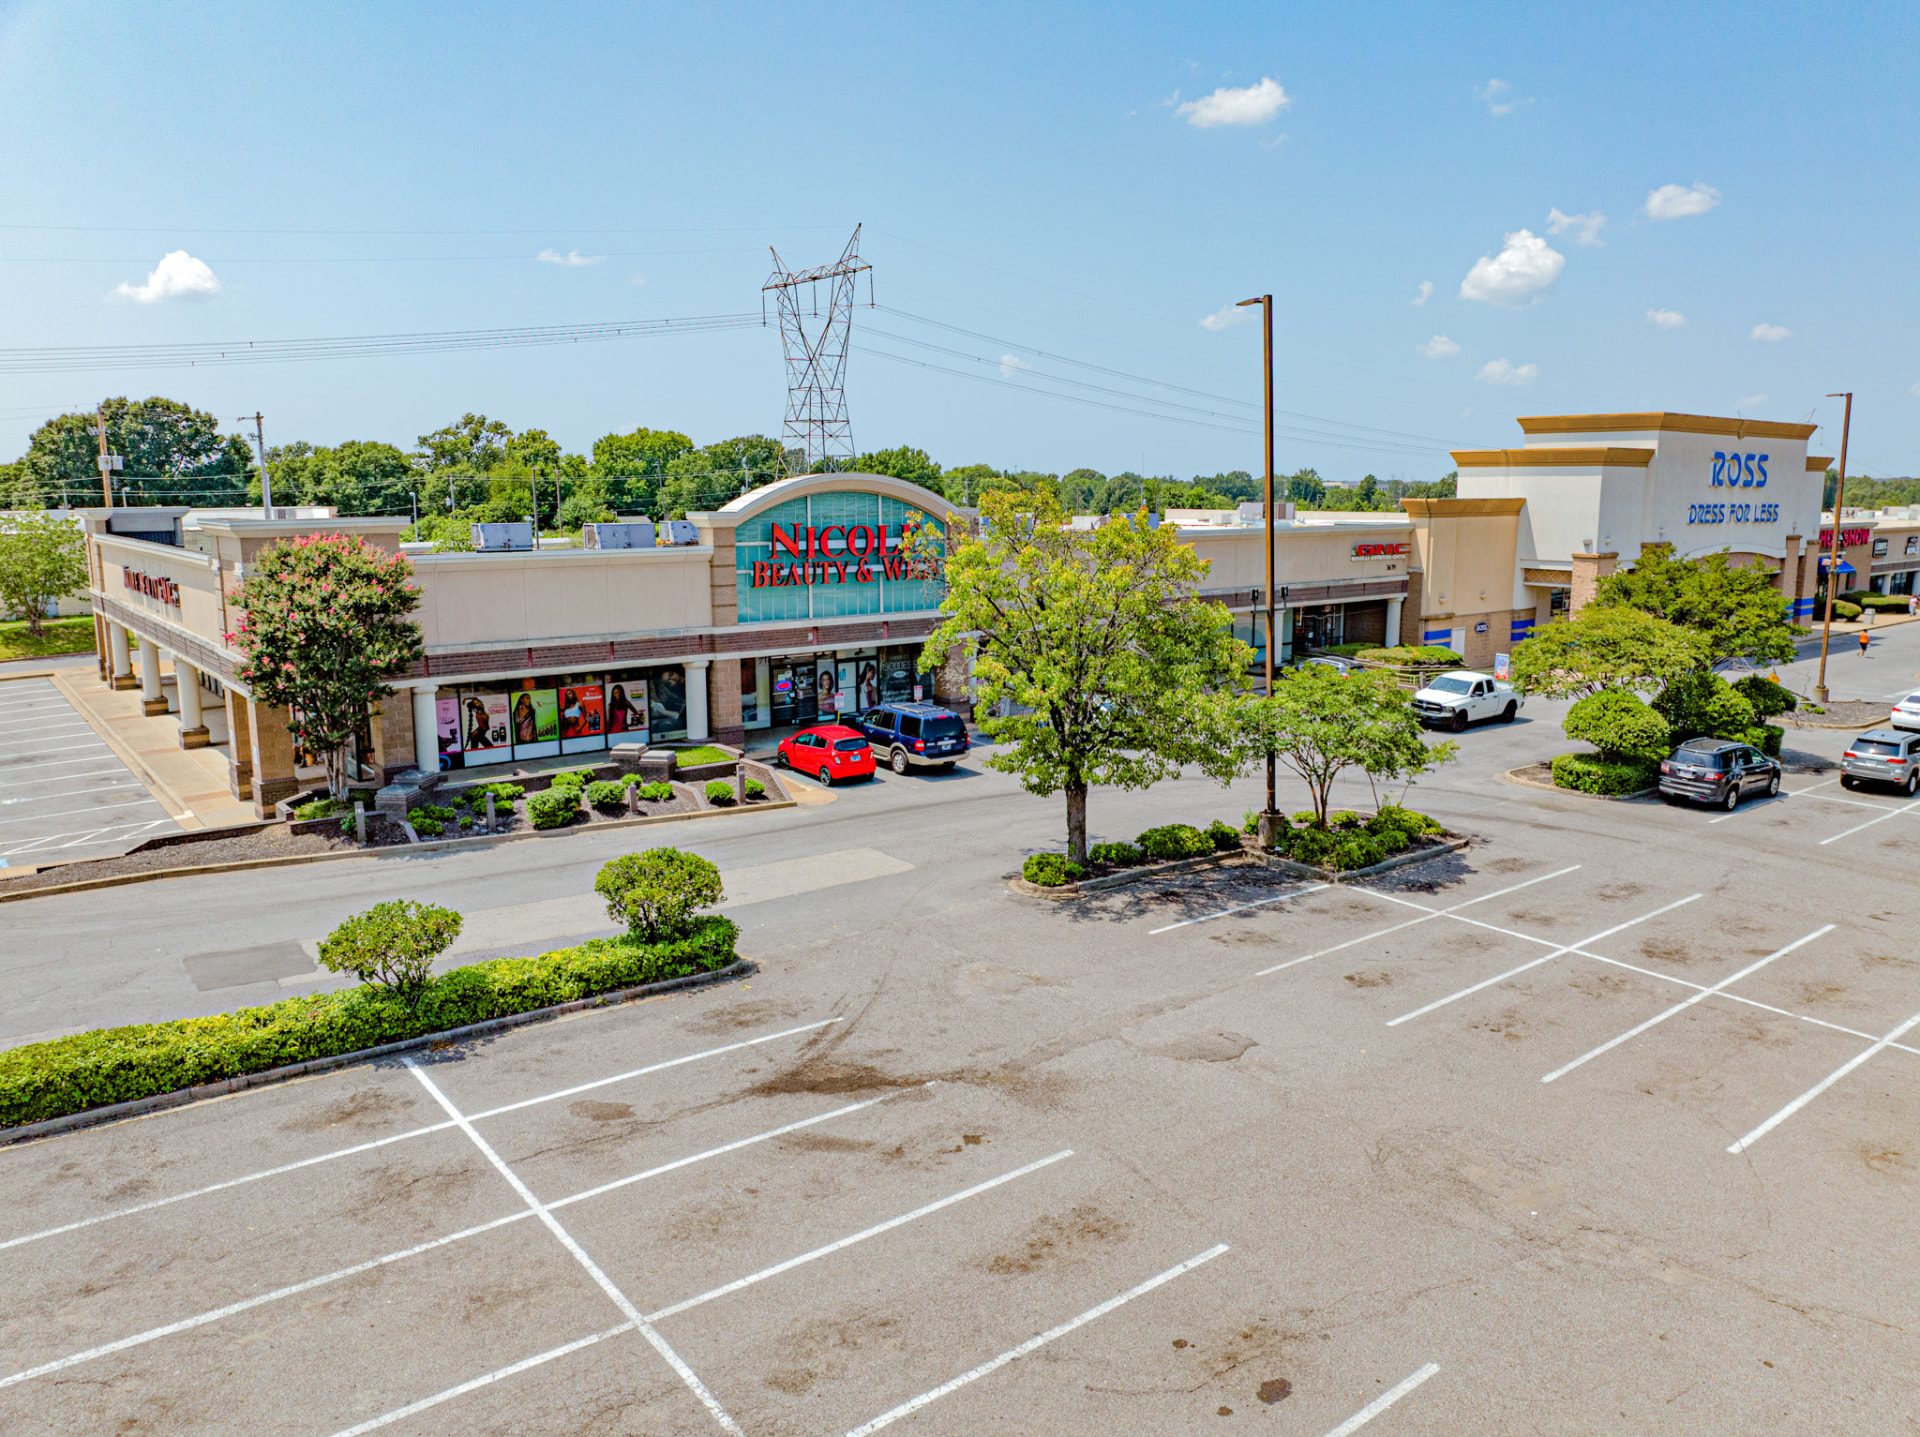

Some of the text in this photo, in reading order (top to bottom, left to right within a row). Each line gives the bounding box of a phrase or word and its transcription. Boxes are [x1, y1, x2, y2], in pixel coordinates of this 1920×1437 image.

[1710, 451, 1769, 488] ROSS
[1688, 503, 1779, 524] DRESS FOR LESS
[1842, 528, 1870, 547] SHOW
[1357, 543, 1411, 556] GNC
[752, 560, 850, 588] BEAUTY
[856, 557, 876, 583] &
